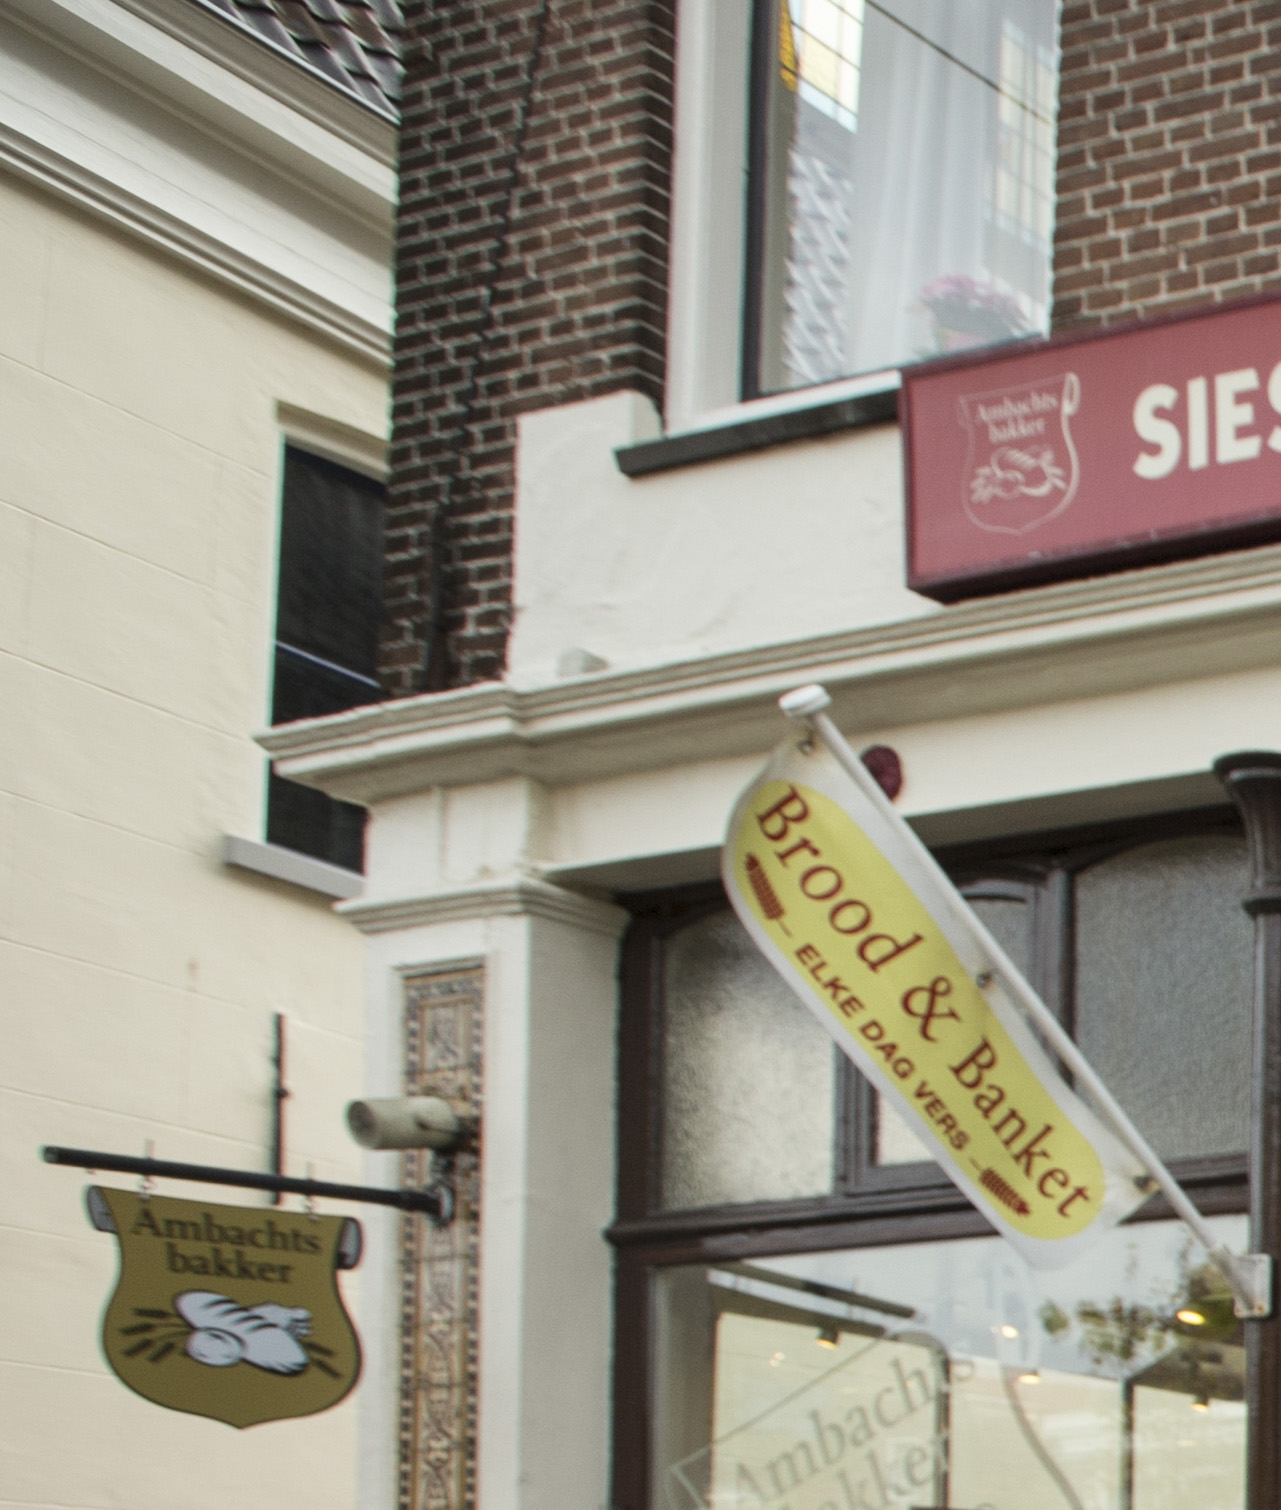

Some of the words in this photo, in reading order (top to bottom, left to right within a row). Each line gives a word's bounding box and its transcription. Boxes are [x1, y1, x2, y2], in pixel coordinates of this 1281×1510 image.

[754, 786, 923, 974] Brood
[902, 975, 960, 1042] &
[948, 1036, 1091, 1218] Banket
[794, 943, 864, 1019] ELKE
[859, 1020, 914, 1080] DAG
[913, 1081, 970, 1153] VERS
[132, 1208, 322, 1255] Ambachts
[166, 1242, 294, 1284] bakker
